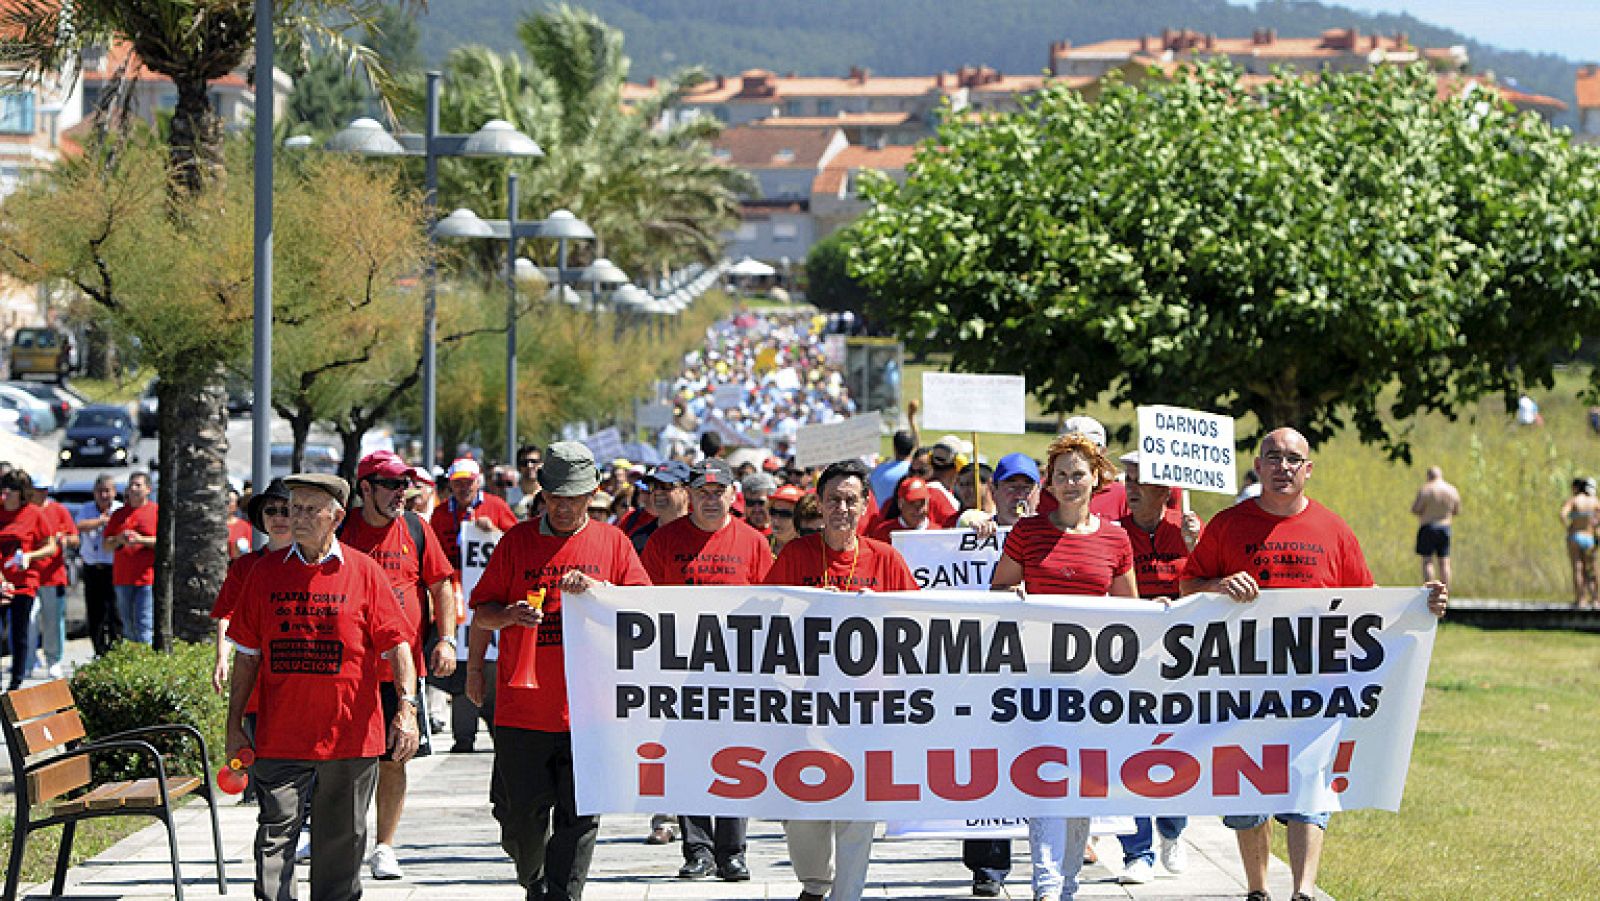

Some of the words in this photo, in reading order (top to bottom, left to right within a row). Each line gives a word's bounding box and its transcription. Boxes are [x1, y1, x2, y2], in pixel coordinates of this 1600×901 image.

[1155, 412, 1218, 438] DARNOS
[1143, 436, 1166, 454] OS
[1170, 440, 1231, 465] CARTOS
[1151, 463, 1226, 488] LADRONS
[960, 533, 1008, 551] BA
[1246, 542, 1324, 553] PLATAFORMA
[1254, 556, 1269, 565] do
[616, 611, 1027, 676] PLATAFORMA
[1050, 622, 1139, 674] DO
[1160, 599, 1384, 679] SALNÉS
[616, 685, 935, 725] PREFERENTES
[990, 685, 1383, 724] SUBORDINADAS
[707, 733, 1290, 802] SOLUCIÓN
[1331, 740, 1356, 793] !
